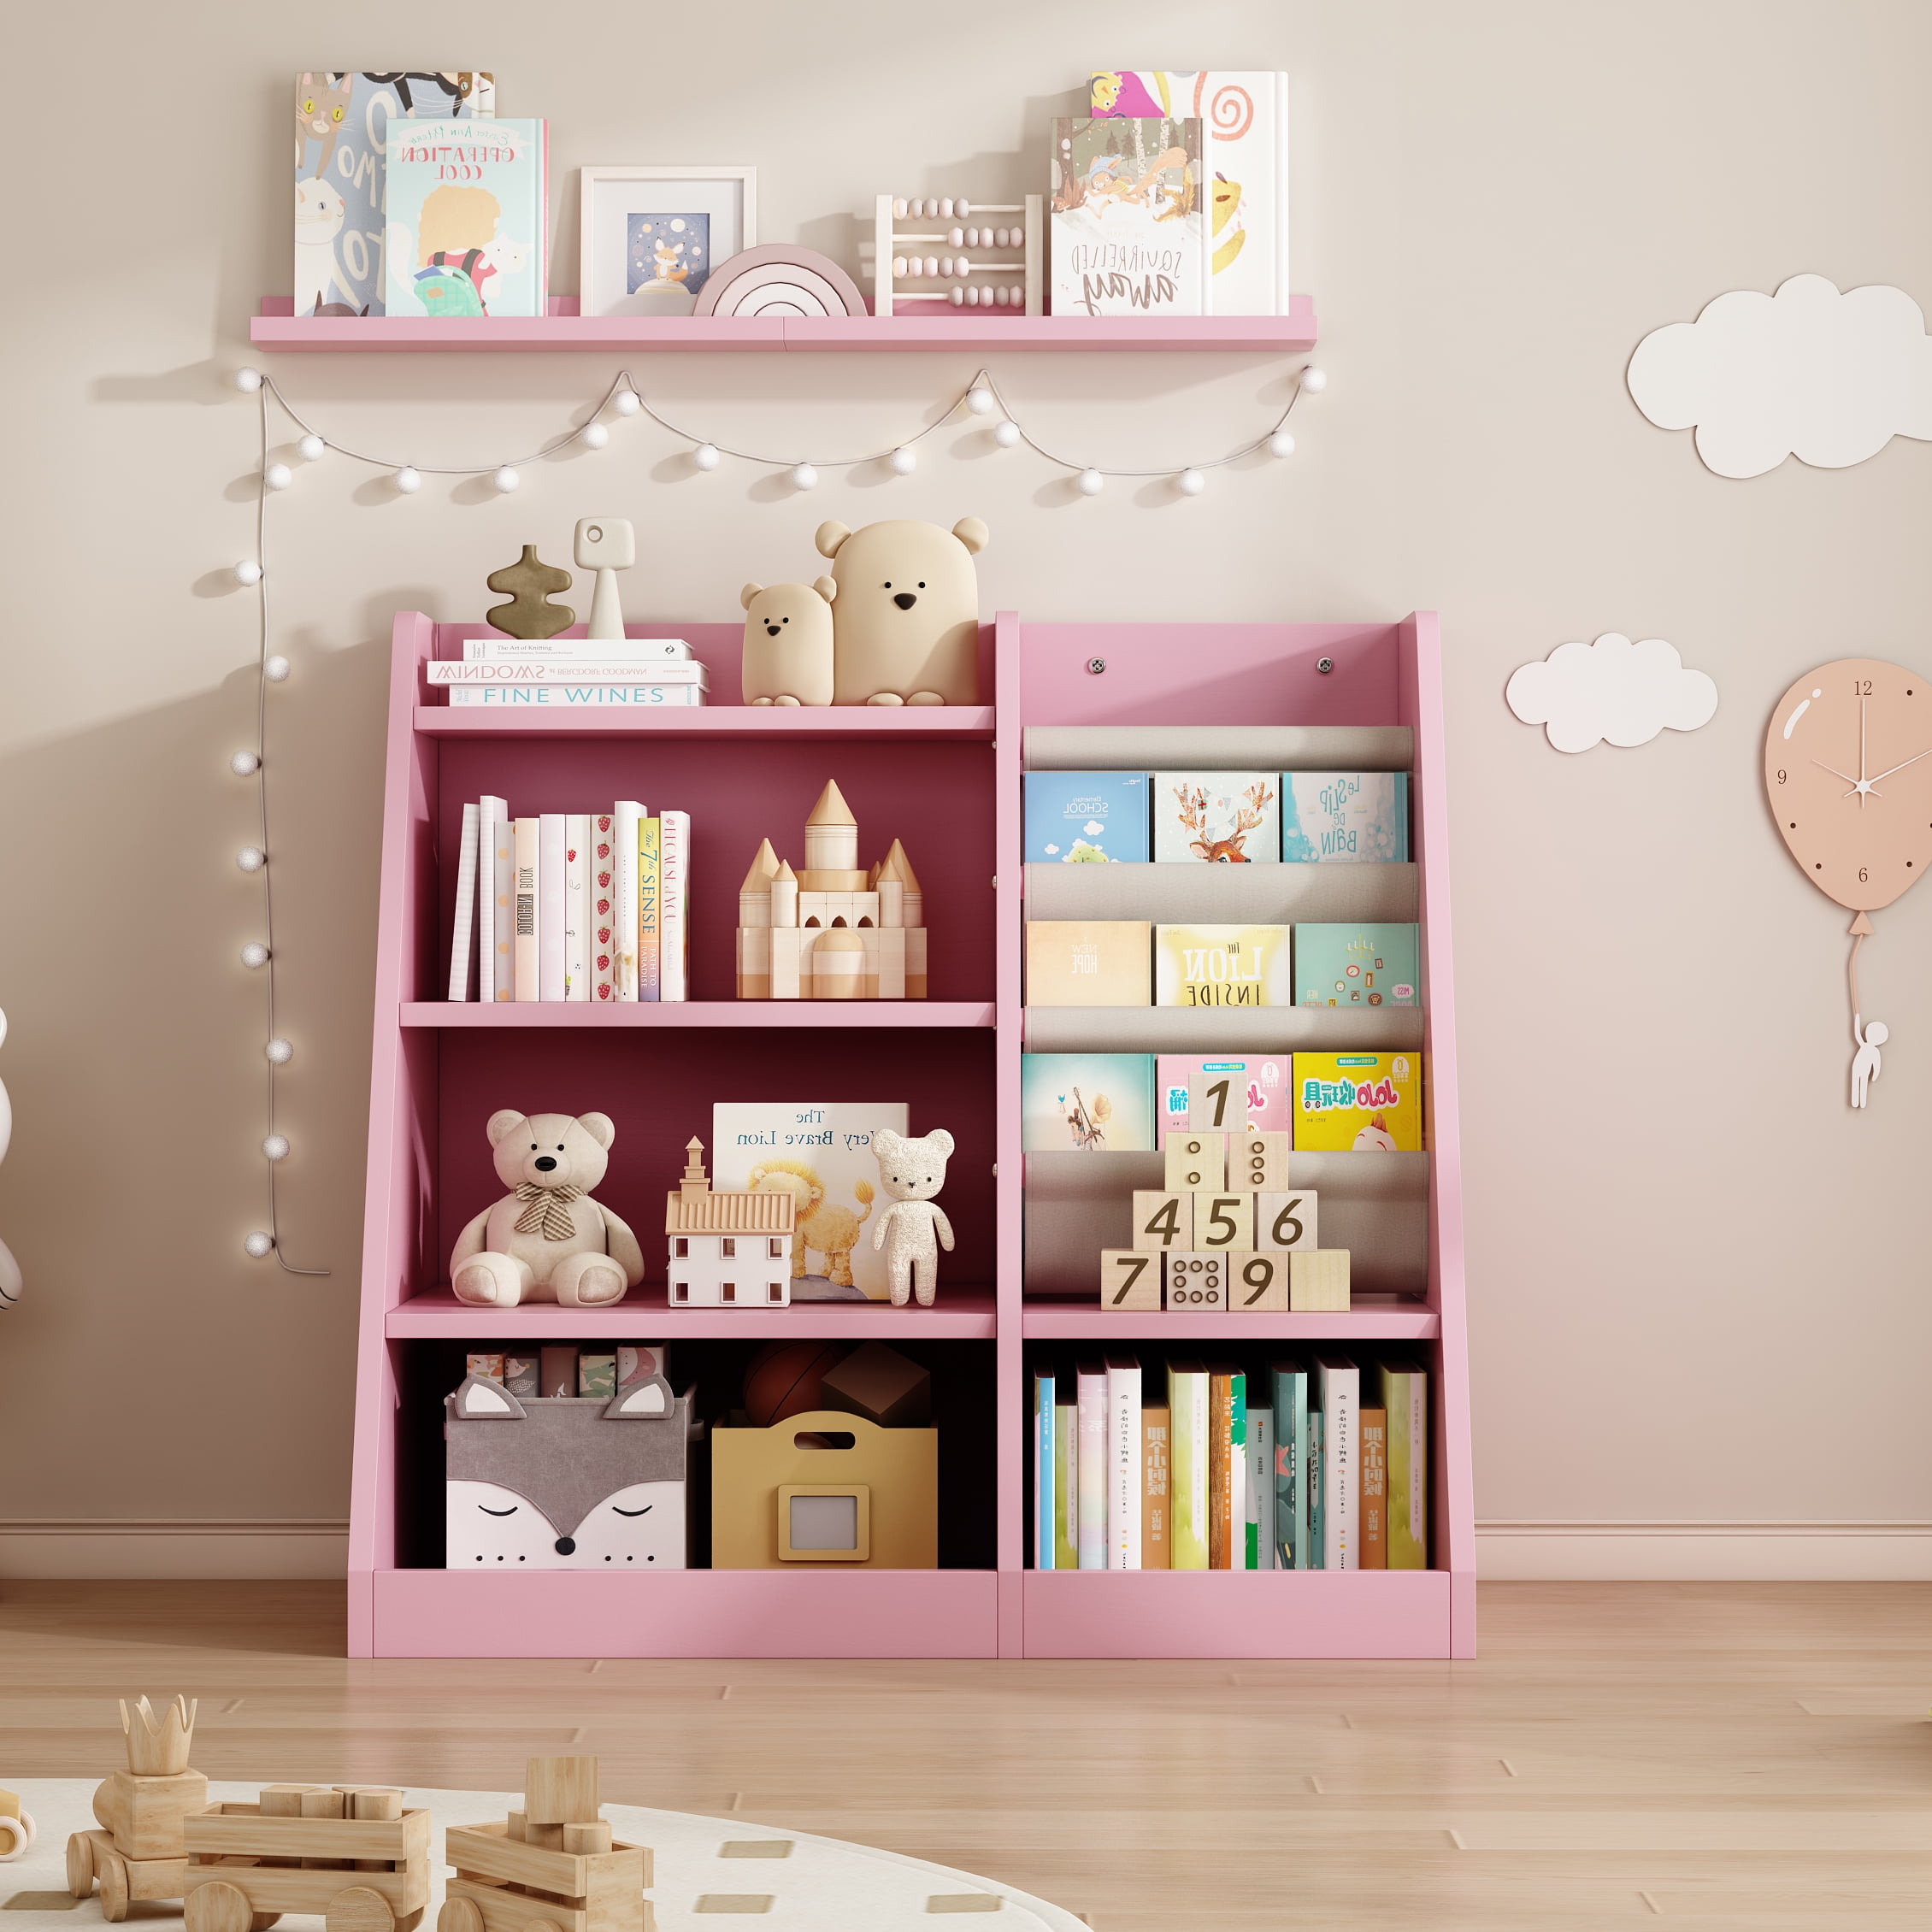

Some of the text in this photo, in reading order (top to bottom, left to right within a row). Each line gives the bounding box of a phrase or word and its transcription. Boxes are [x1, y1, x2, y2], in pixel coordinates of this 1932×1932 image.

[484, 687, 551, 704] FINE
[564, 687, 665, 704] WINES
[1853, 680, 1873, 697] 12
[1777, 769, 1787, 785] 9
[663, 828, 677, 884] BECAUSE
[1858, 867, 1869, 883] 6
[641, 874, 656, 934] SENSE
[663, 896, 677, 924] YOU
[649, 971, 657, 987] TO
[1205, 1079, 1231, 1128] 1
[1144, 1198, 1181, 1246] 4
[1205, 1198, 1242, 1246] 5
[1271, 1198, 1304, 1246] 6
[1111, 1258, 1150, 1305] 7
[1242, 1258, 1275, 1306] 9
